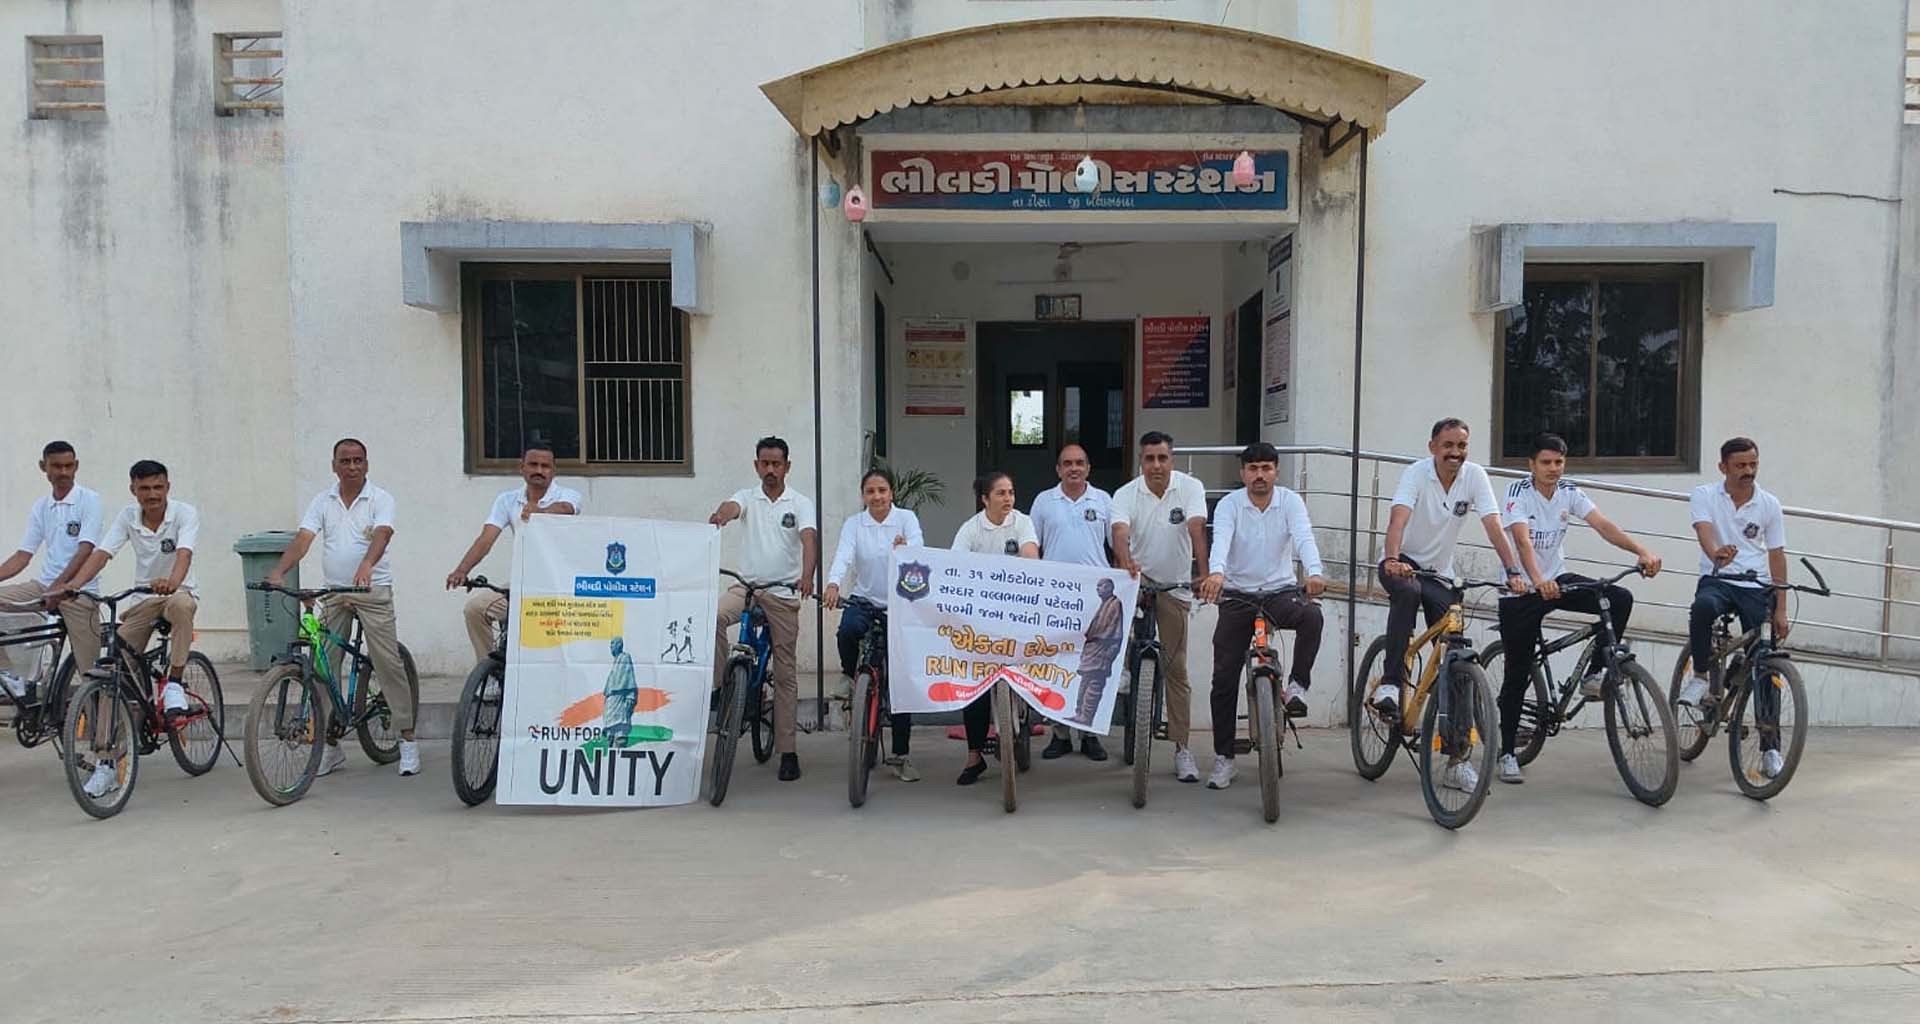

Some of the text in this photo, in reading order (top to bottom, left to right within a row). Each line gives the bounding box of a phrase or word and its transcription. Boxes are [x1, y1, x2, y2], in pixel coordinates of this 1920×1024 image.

[880, 157, 1011, 194] ભીલડી
[944, 567, 961, 578] તા.
[968, 569, 984, 580] ૩૧
[1050, 580, 1082, 593] ૨૦૨૫
[936, 601, 973, 616] ૧૫૦મી
[978, 607, 1004, 621] જન્મ
[938, 584, 1084, 613] સરદાર વલ્લભભાઈ પટેલની
[926, 655, 968, 679] RUN
[972, 662, 1008, 679] FO
[541, 726, 601, 741] RUN FOR
[539, 748, 675, 796] UNITY
